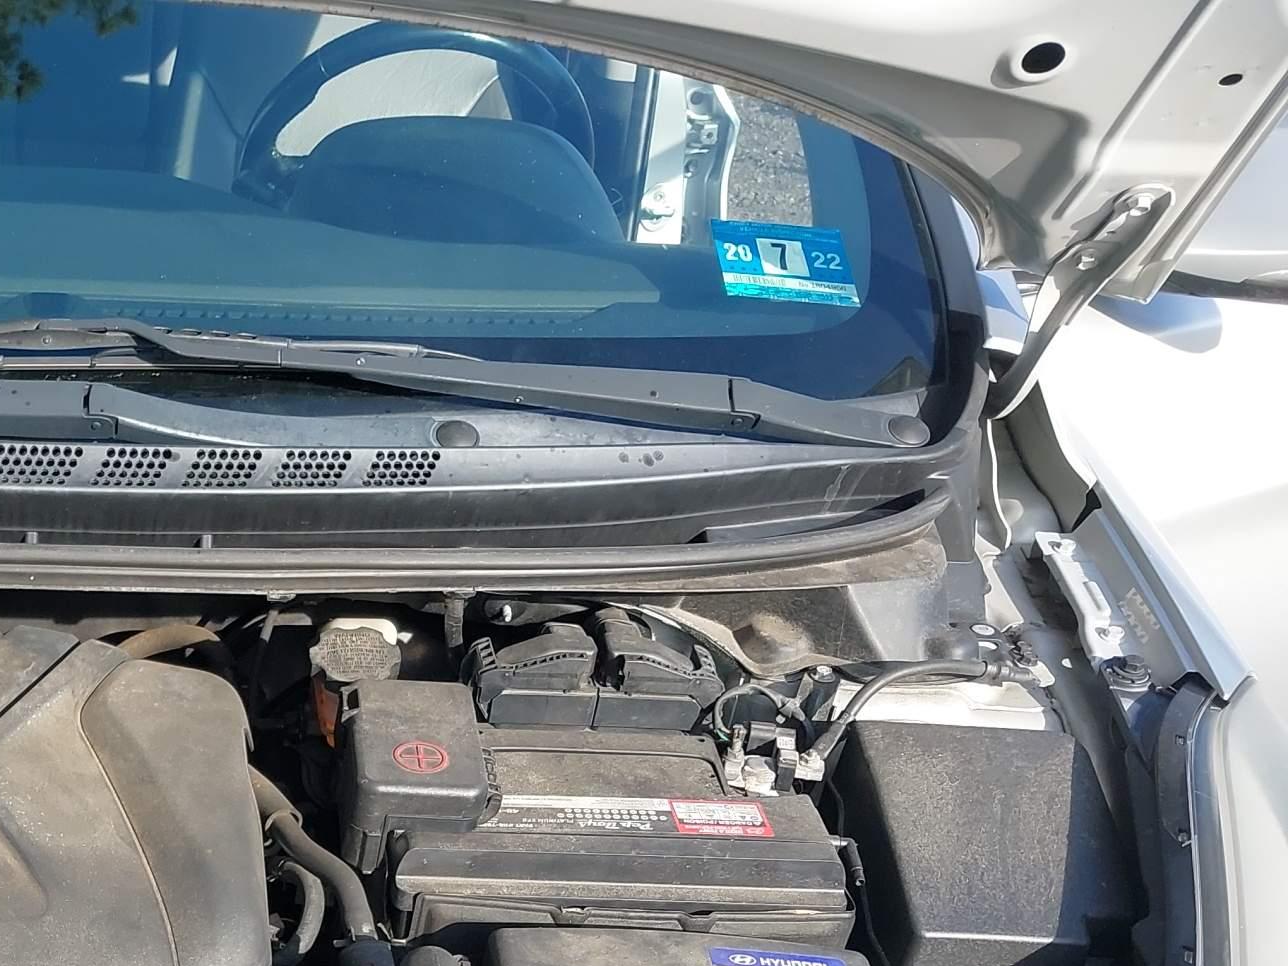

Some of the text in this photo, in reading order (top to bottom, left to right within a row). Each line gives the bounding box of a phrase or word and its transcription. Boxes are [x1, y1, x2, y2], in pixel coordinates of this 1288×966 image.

[723, 242, 844, 271] 20 7 22
